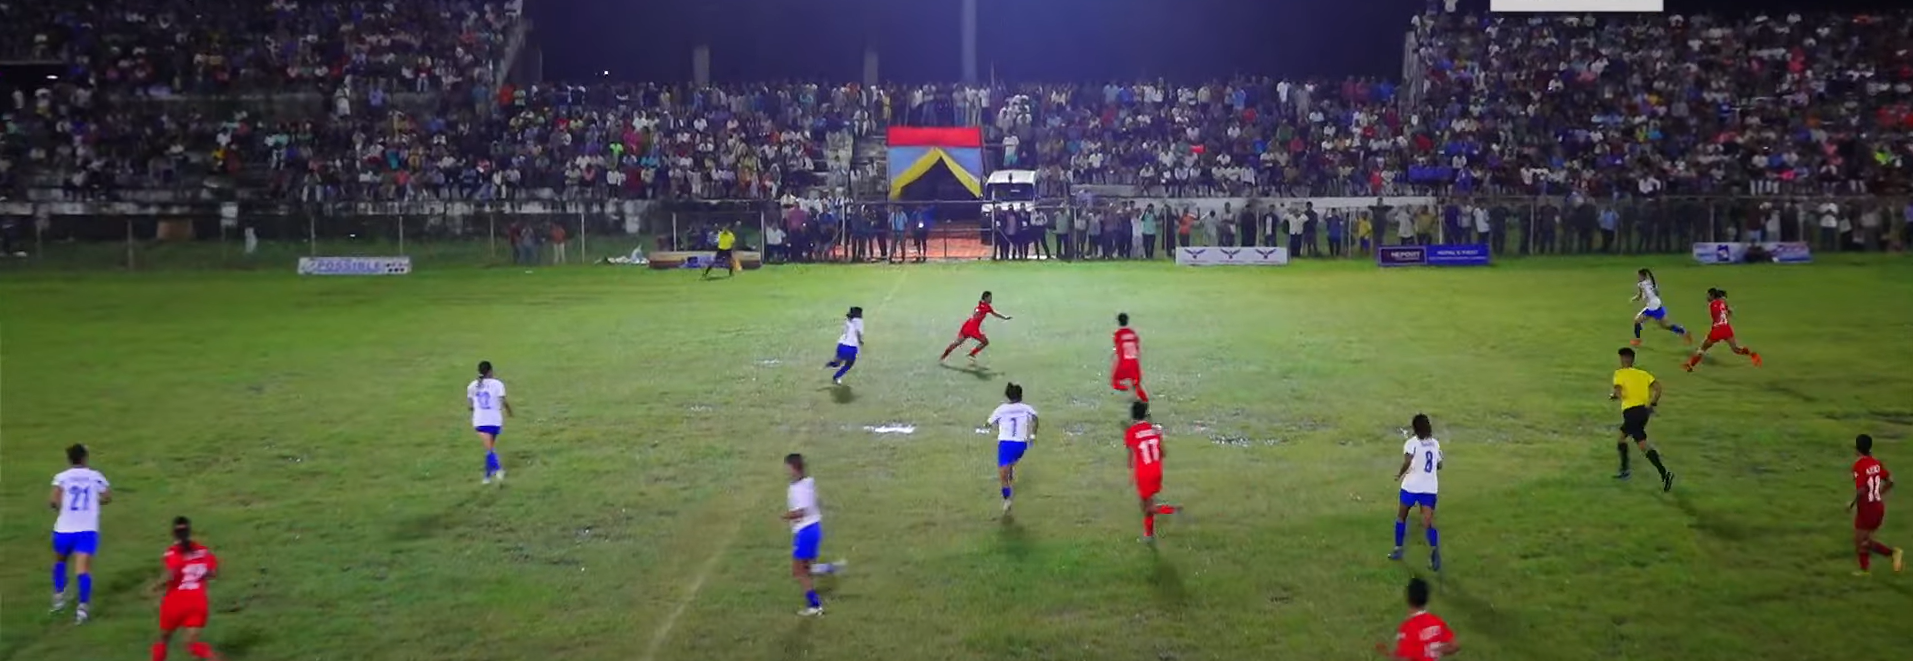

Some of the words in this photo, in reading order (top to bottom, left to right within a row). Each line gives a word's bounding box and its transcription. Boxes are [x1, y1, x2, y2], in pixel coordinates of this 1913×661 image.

[1138, 438, 1159, 464] 17
[1424, 450, 1433, 473] 8
[69, 485, 90, 511] 21
